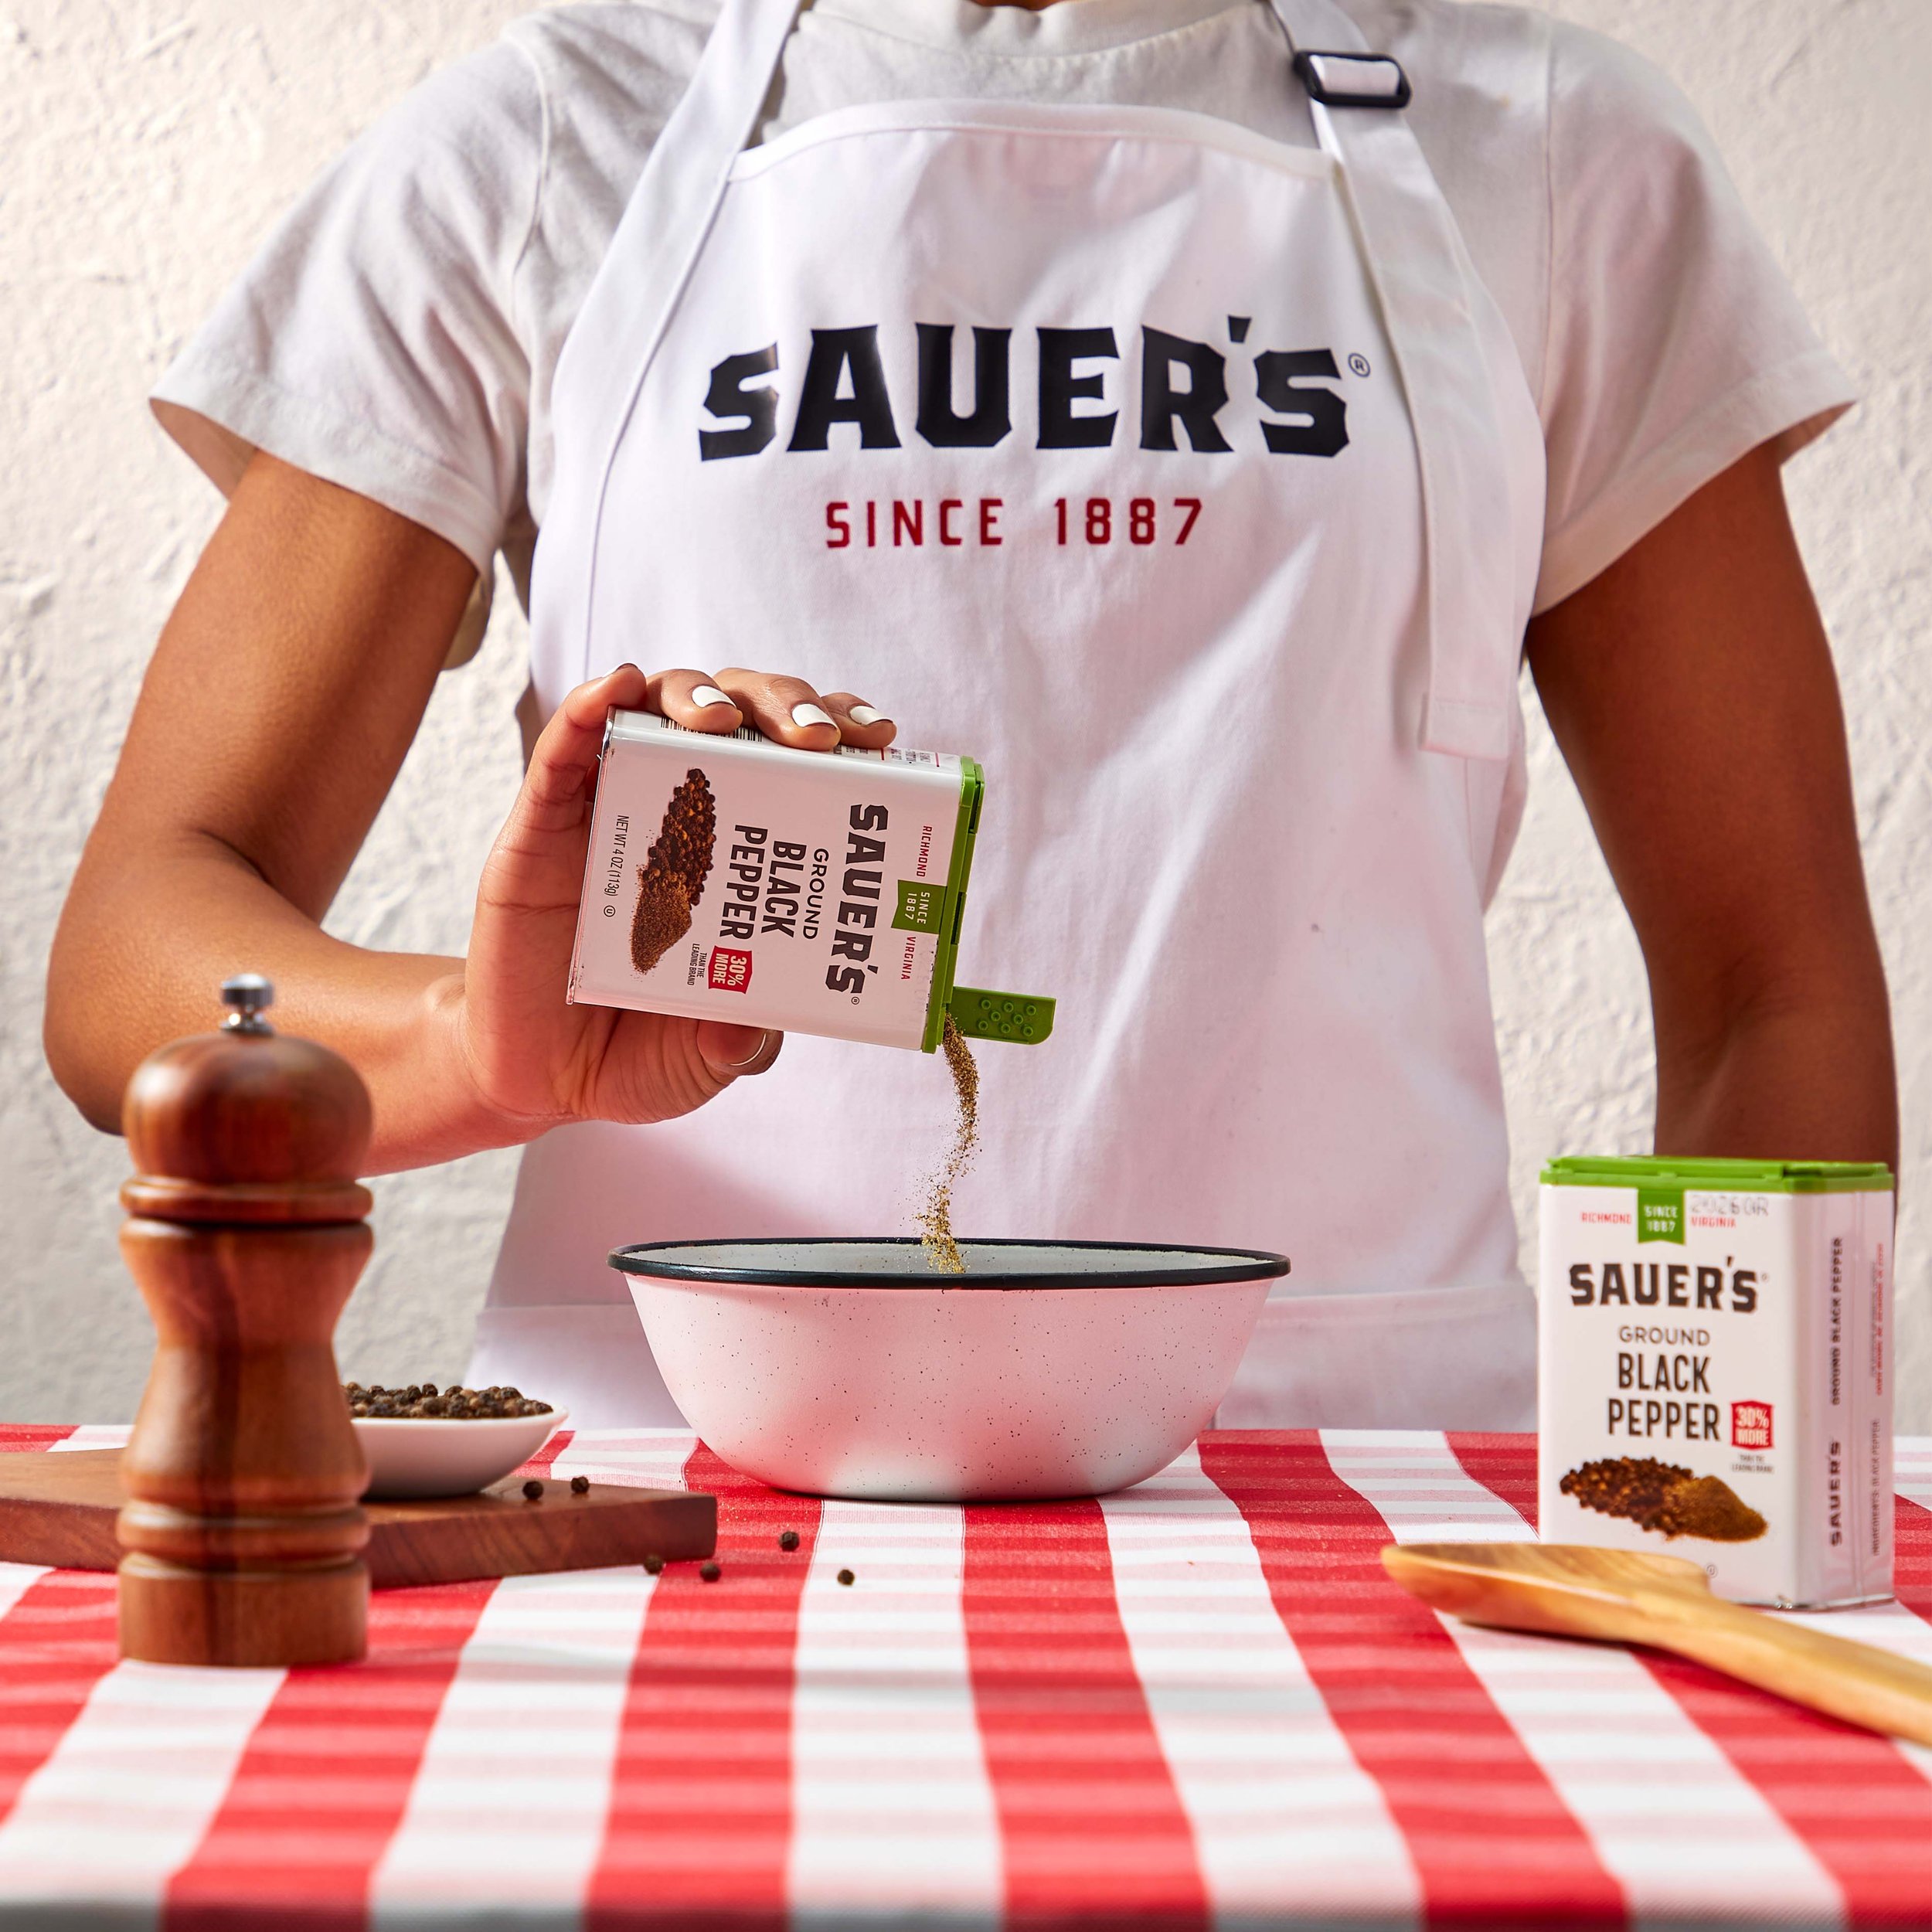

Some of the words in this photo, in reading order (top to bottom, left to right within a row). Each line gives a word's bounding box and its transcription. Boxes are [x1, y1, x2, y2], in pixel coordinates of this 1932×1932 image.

[825, 498, 1004, 549] SINCE
[1055, 498, 1203, 546] 1887
[616, 815, 630, 833] NET
[613, 833, 627, 848] WT
[917, 825, 932, 877] RICHMOND
[610, 856, 623, 869] OZ
[604, 870, 621, 896] (113g)
[719, 825, 768, 940] PEPPER
[760, 840, 807, 938] BLACK
[802, 848, 829, 940] GROUND
[905, 893, 917, 920] 1887
[917, 891, 930, 924] SINCE
[689, 943, 700, 966] LEADING
[698, 952, 707, 967] THAN
[712, 953, 729, 985] MORE
[901, 937, 917, 980] VIRGINIA
[686, 967, 697, 986] BRAND
[696, 968, 706, 978] THE
[726, 955, 747, 987] 30%
[1644, 1205, 1679, 1219] SINCE
[1646, 1219, 1676, 1233] 1887
[1691, 1216, 1737, 1228] VIRGINIA
[1832, 1237, 1842, 1293] PEPPER
[1570, 1256, 1758, 1314] SAUER'S
[1832, 1298, 1842, 1343] BLACK
[1619, 1325, 1711, 1346] GROUND
[1617, 1352, 1712, 1394] BLACK
[1832, 1348, 1842, 1406] GROUND
[1607, 1398, 1721, 1441] PEPPER
[1735, 1406, 1770, 1429] 30%
[1736, 1427, 1770, 1447] MORE
